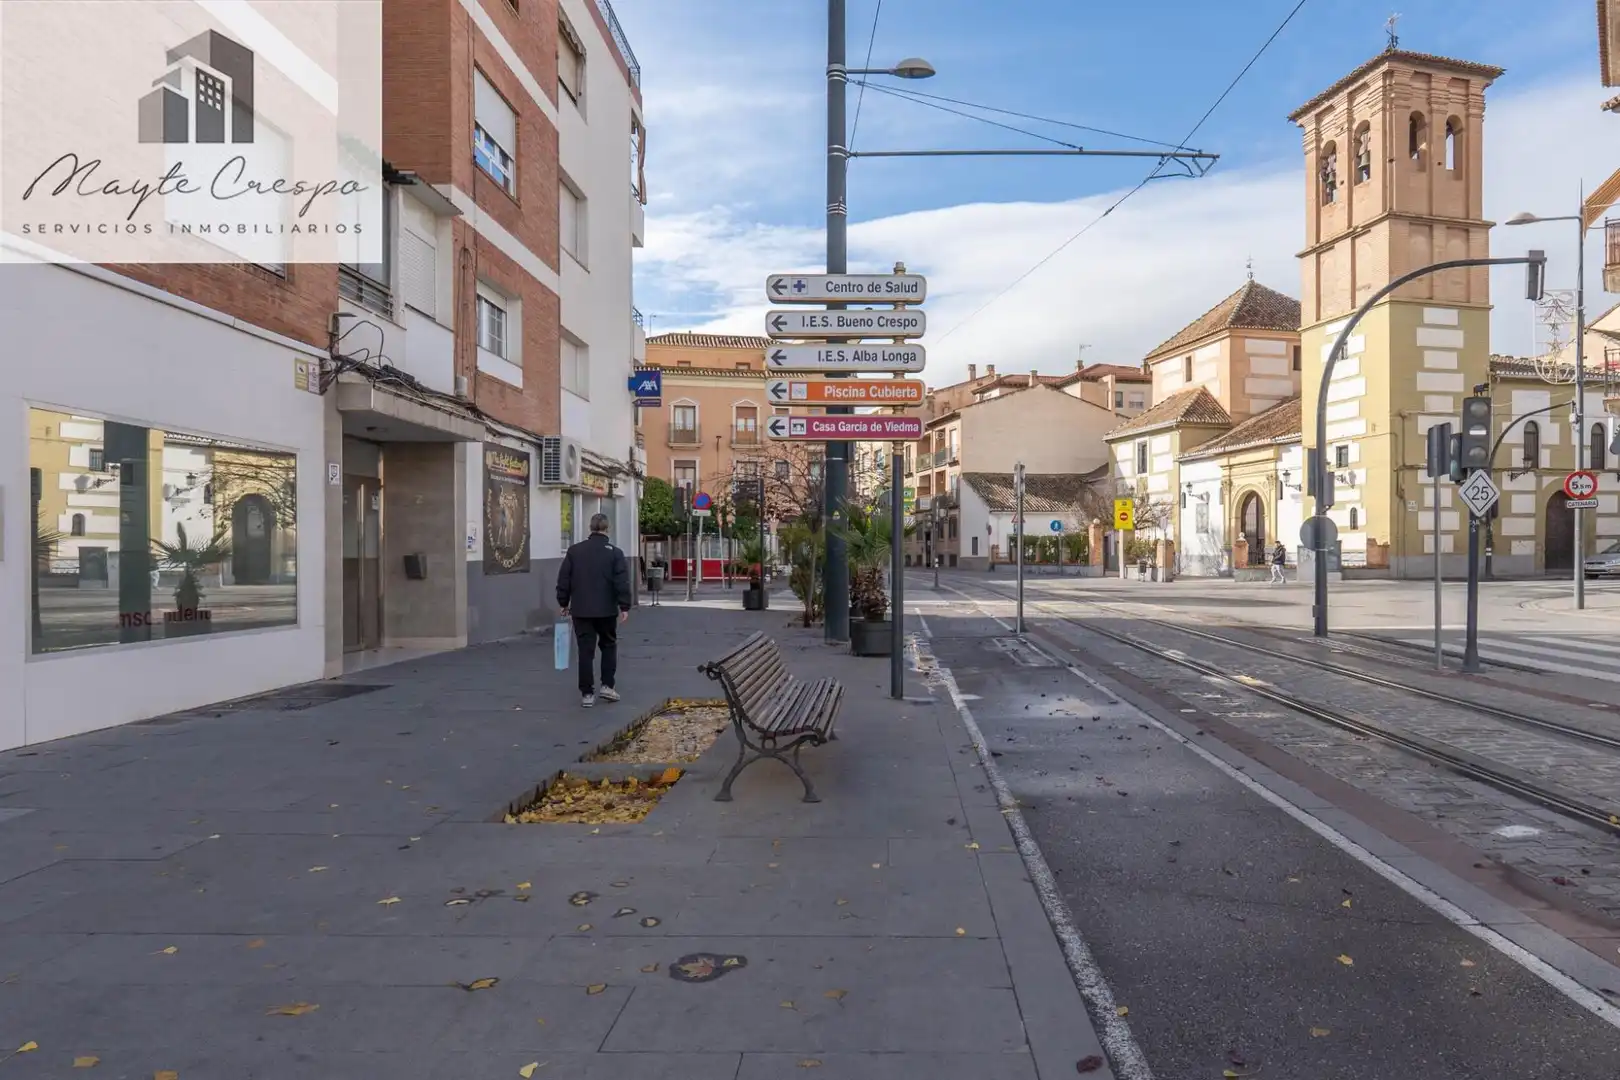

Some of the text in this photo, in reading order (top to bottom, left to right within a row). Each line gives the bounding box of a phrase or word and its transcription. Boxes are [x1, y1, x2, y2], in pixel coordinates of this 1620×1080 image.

[825, 281, 918, 293] Centro de Salud
[802, 315, 918, 330] I.E.S. Bueno Crespo
[818, 350, 917, 364] I.E.S. Alba Longa
[638, 380, 658, 391] AXA
[824, 385, 918, 398] Piscina Cubierta
[812, 421, 836, 432] Casa
[870, 421, 882, 432] de
[885, 421, 919, 432] Viedma
[1471, 485, 1489, 500] 25
